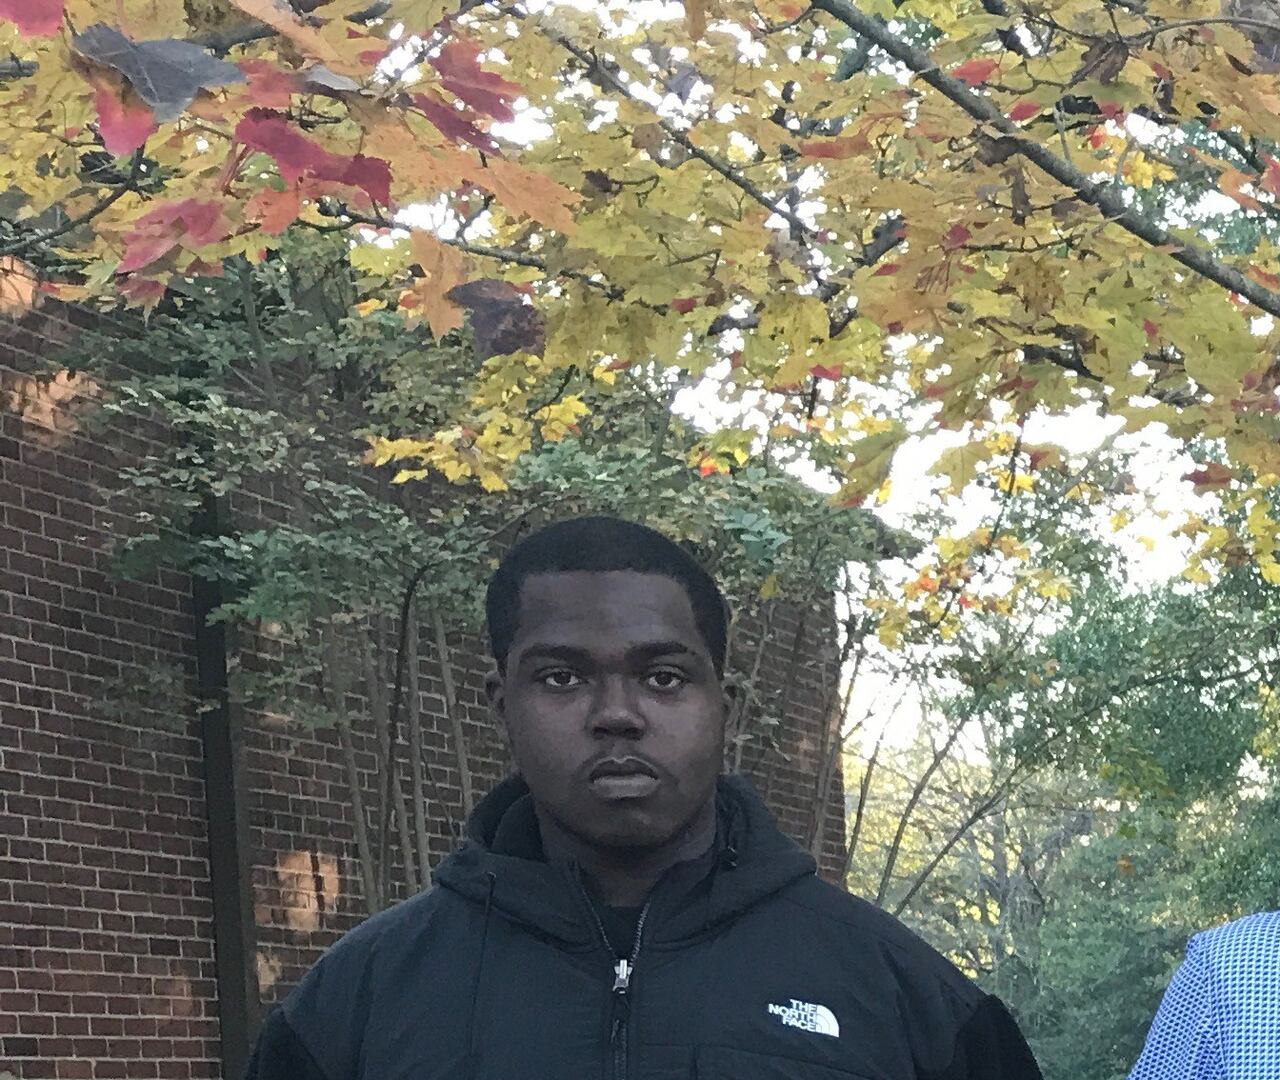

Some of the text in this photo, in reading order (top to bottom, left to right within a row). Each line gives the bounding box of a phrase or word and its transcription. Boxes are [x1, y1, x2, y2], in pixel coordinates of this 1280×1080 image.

[768, 1003, 816, 1022] NORTH
[789, 998, 816, 1013] THE
[782, 1015, 816, 1032] FACE
